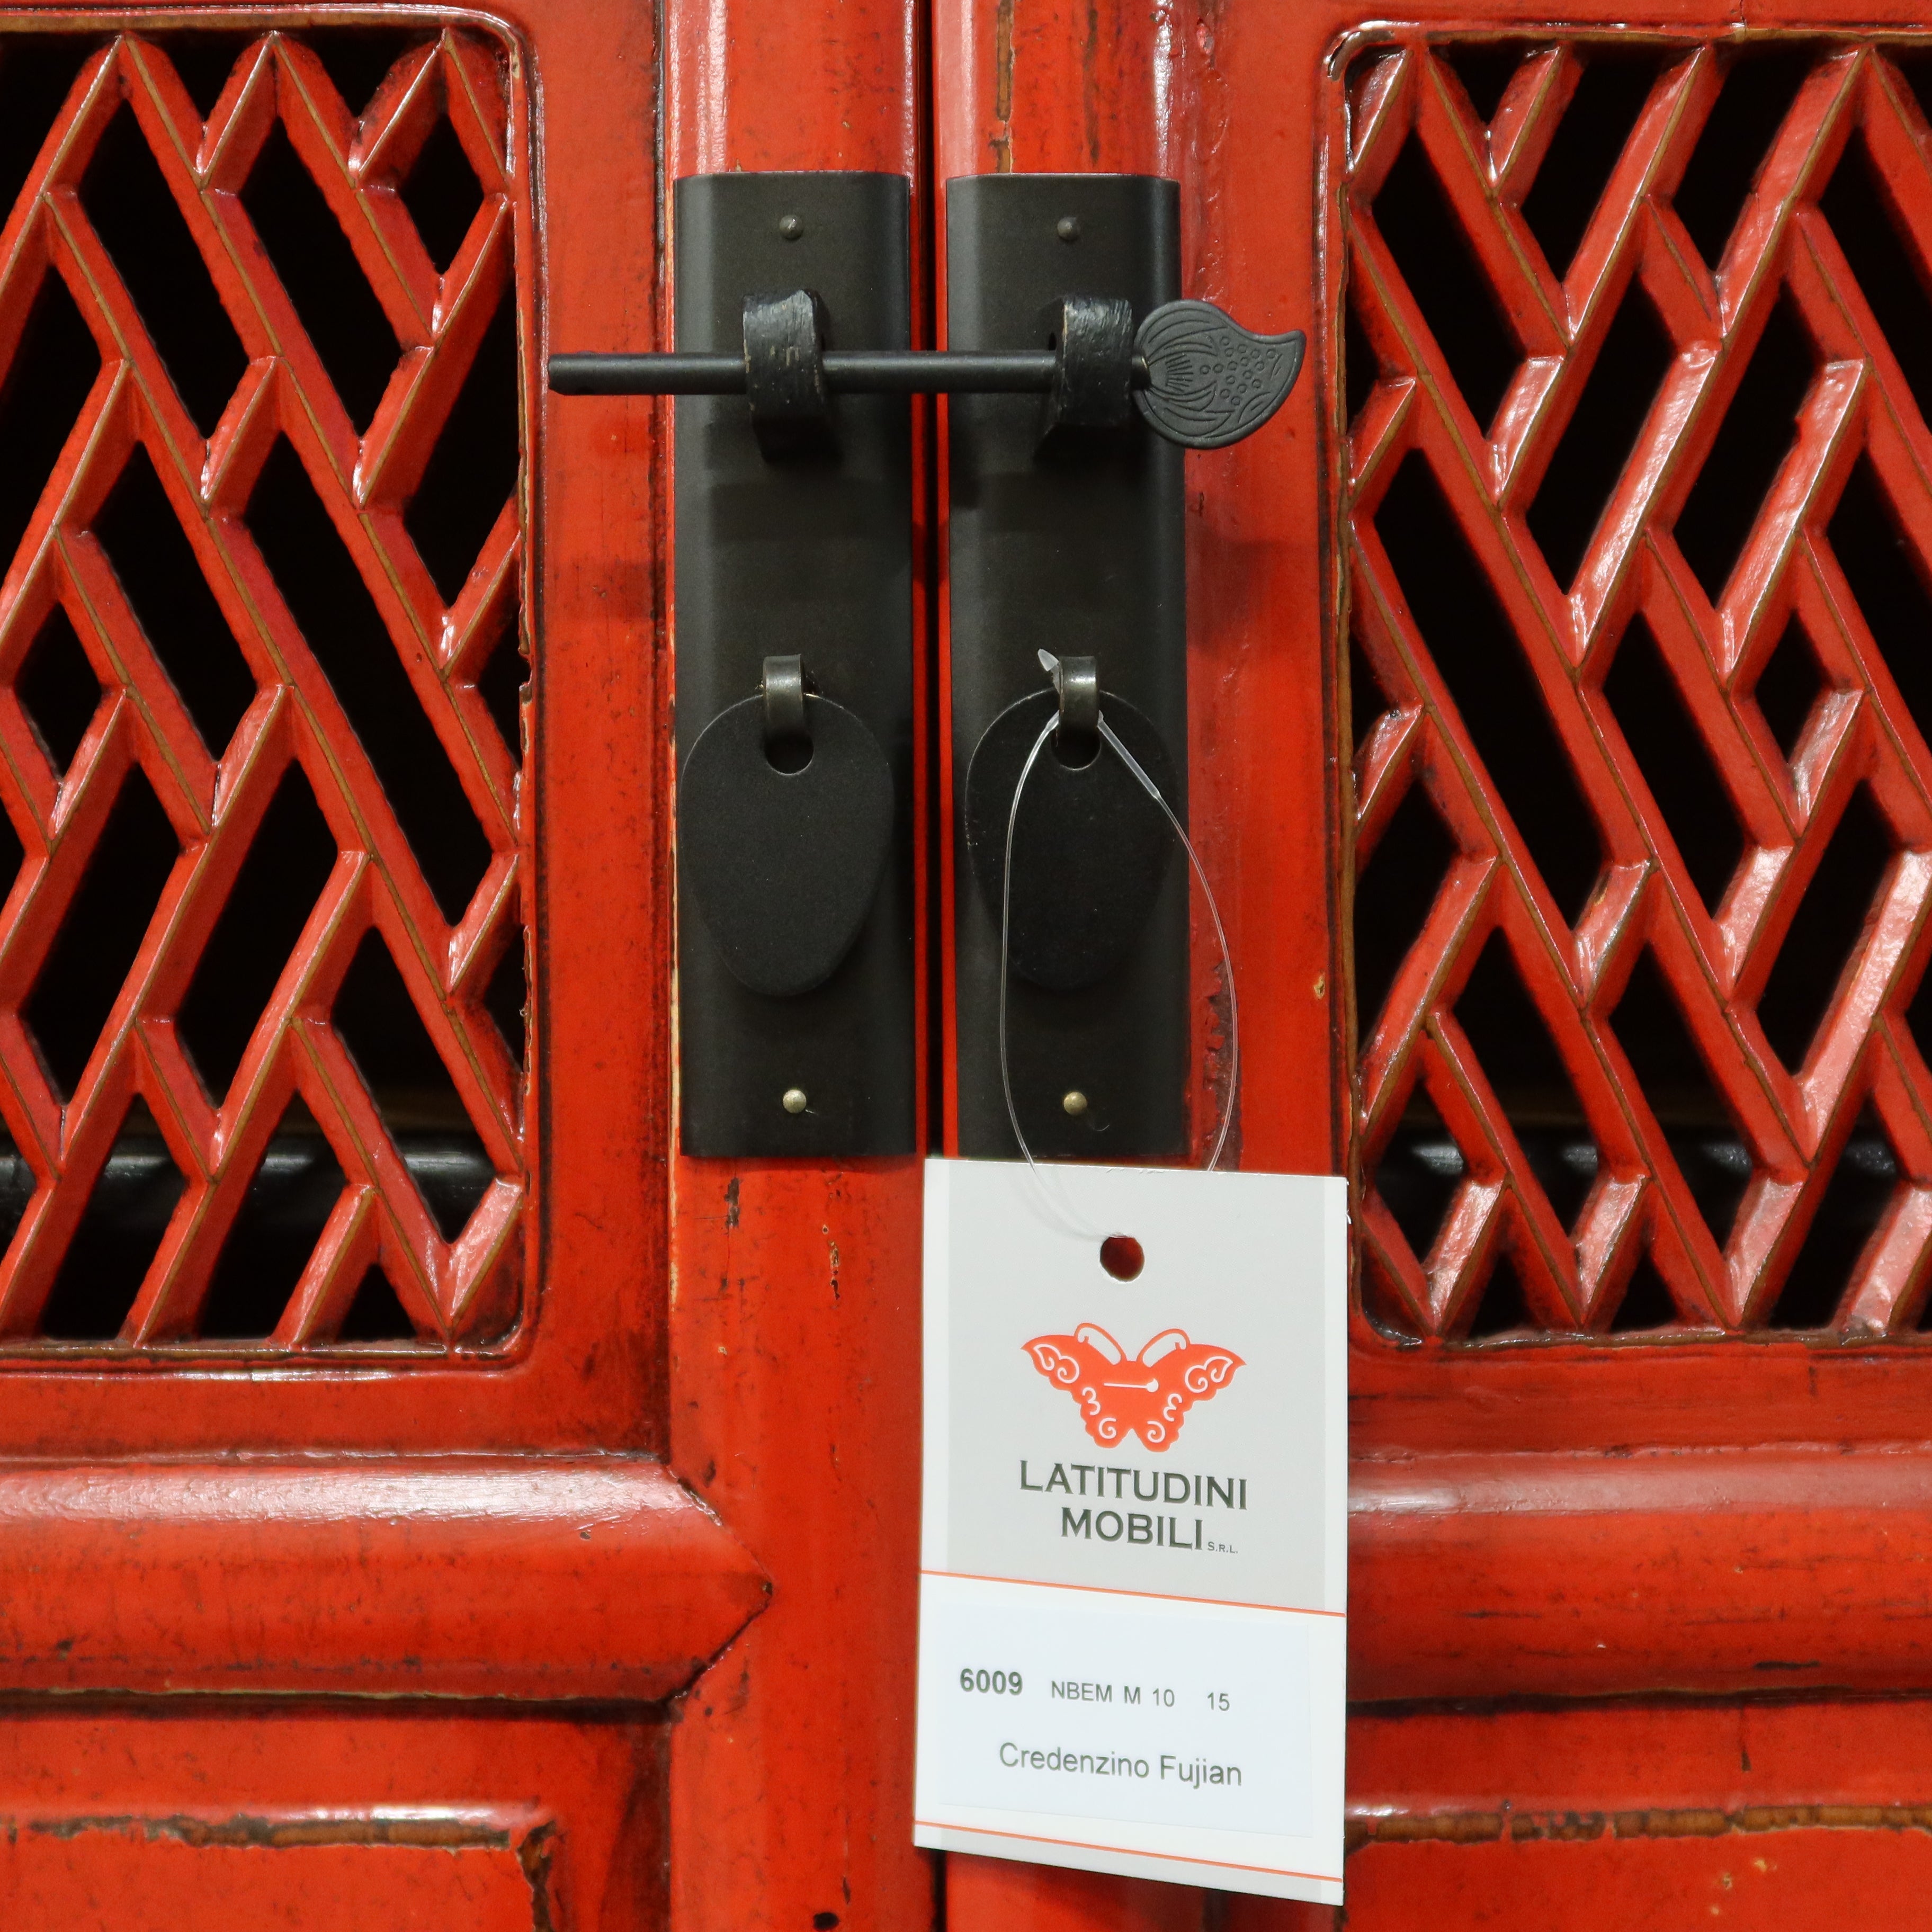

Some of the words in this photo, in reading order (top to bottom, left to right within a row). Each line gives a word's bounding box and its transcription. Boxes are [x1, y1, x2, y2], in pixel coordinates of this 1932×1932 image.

[1020, 1460, 1247, 1510] LATITUDINI
[1061, 1507, 1203, 1550] MOBILI
[1208, 1542, 1239, 1554] S.R.L.
[960, 1668, 1023, 1696] 6009
[1051, 1680, 1113, 1703] NBEM
[1124, 1686, 1141, 1705] M
[1152, 1688, 1175, 1707] 10
[1207, 1692, 1230, 1711] 15
[999, 1742, 1150, 1778] Credenzino
[1160, 1755, 1242, 1790] Fujian
